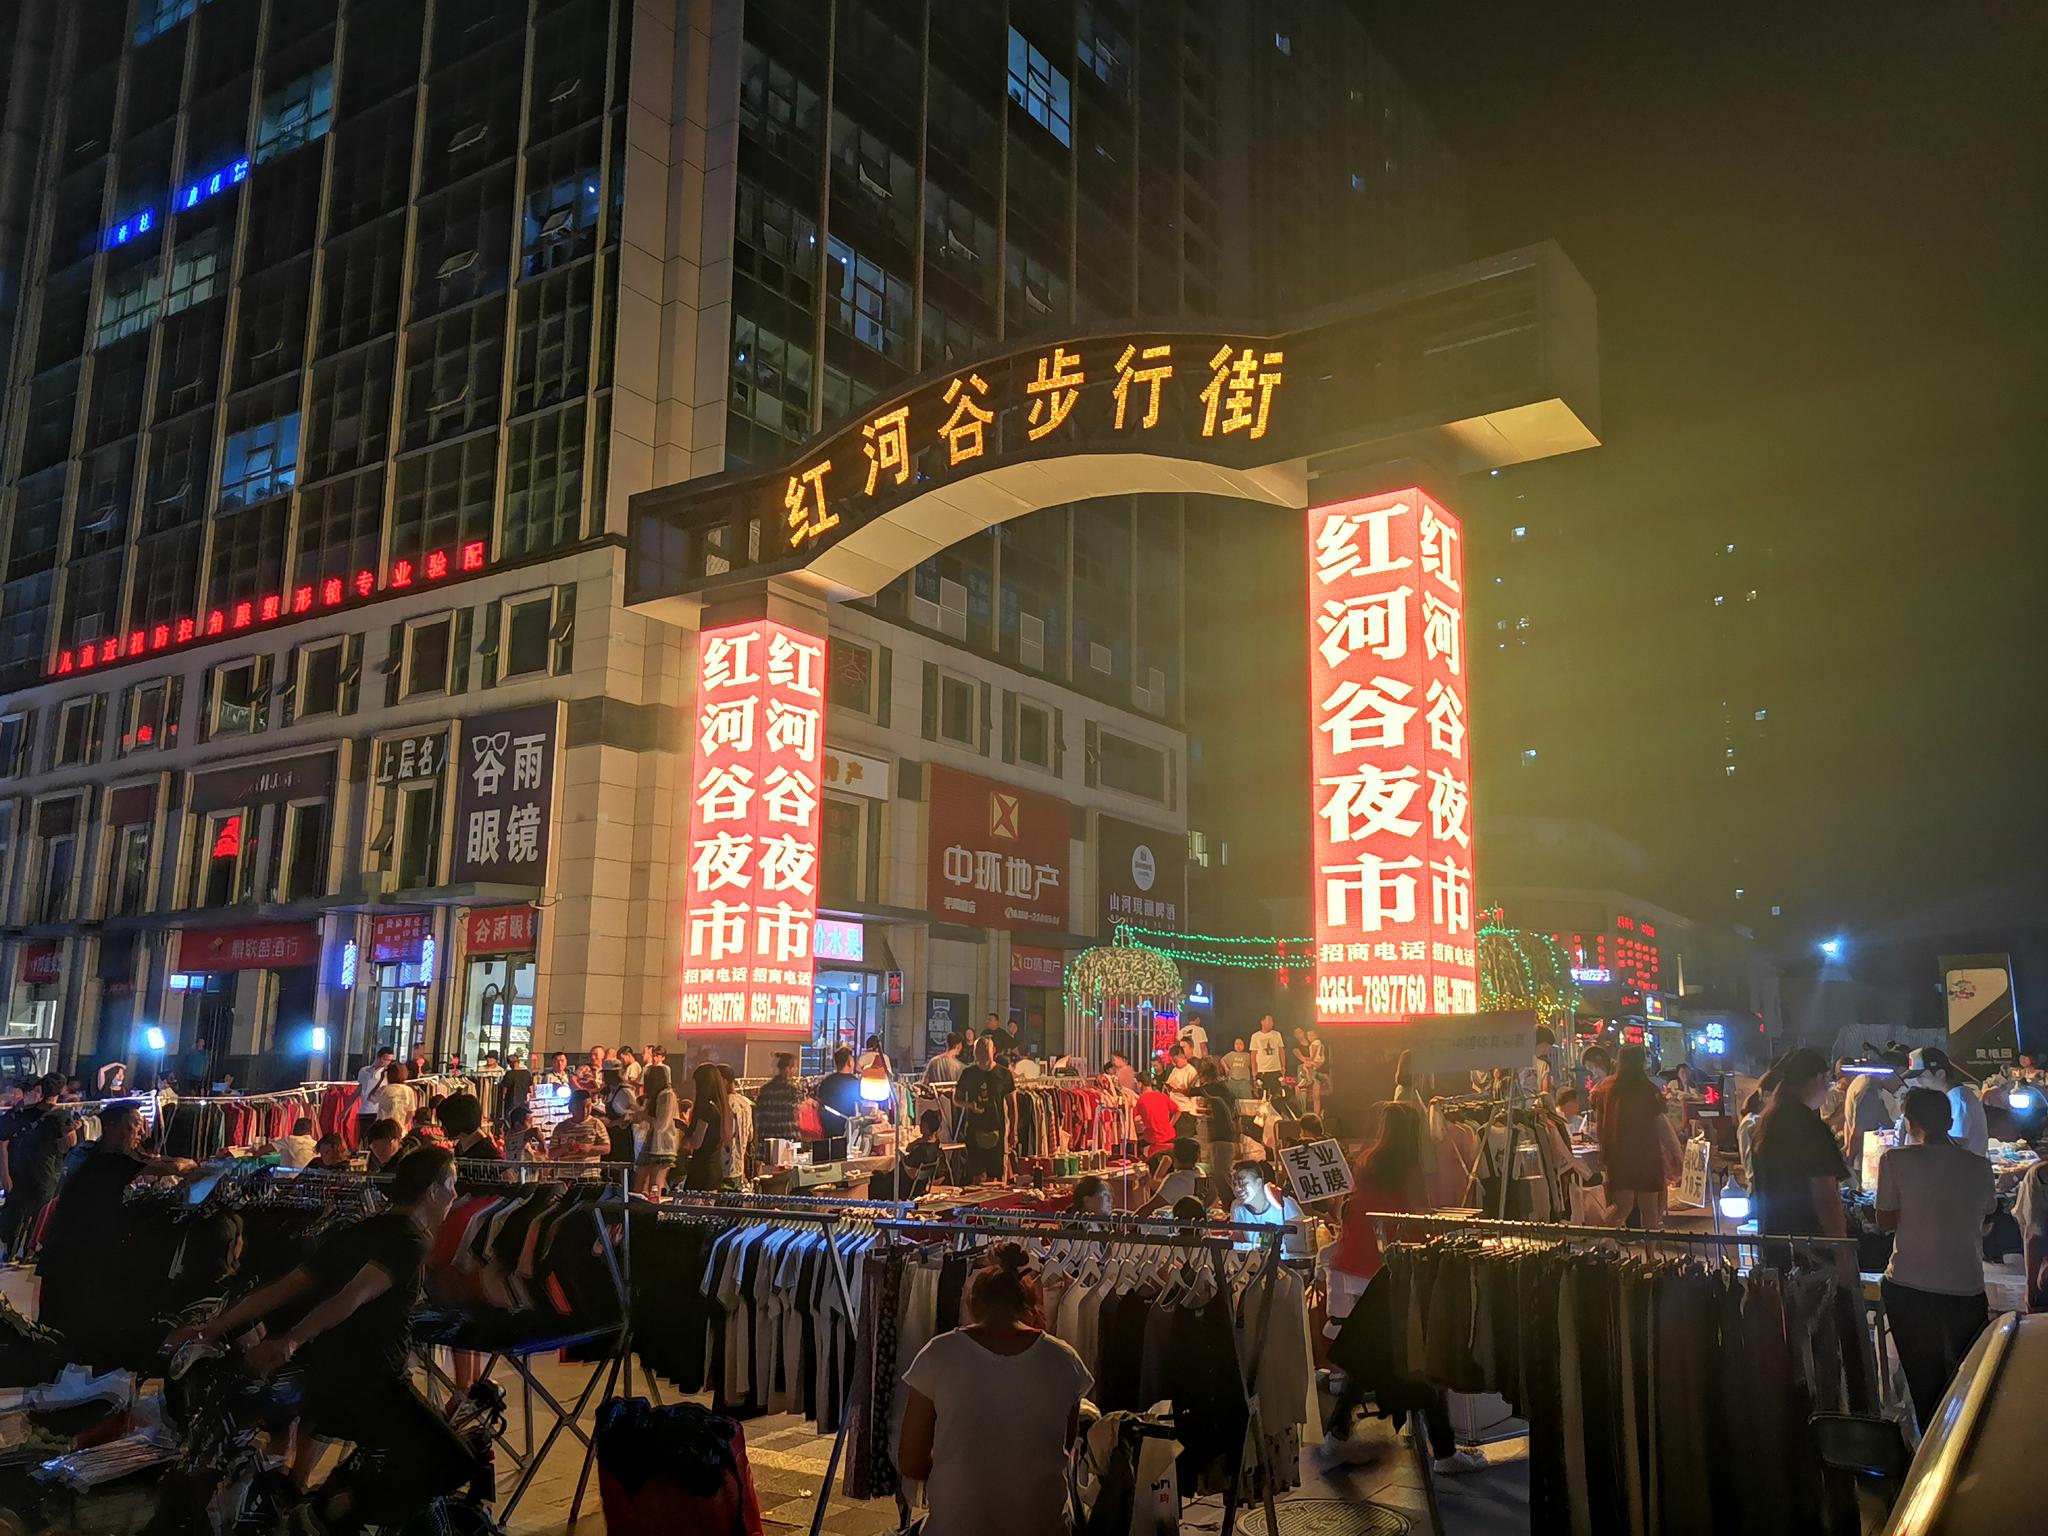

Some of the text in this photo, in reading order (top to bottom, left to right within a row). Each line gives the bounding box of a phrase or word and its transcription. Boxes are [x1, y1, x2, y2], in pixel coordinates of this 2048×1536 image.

[784, 344, 1283, 548] 红河谷步行街
[1316, 503, 1423, 933] 红河谷夜市
[1420, 505, 1472, 935] 红河谷夜市
[471, 731, 546, 797] 谷雨
[689, 631, 761, 961] 红河谷夜市
[755, 632, 822, 963] 红河谷夜市
[466, 802, 542, 866] 眼镜
[943, 844, 1060, 901] 中环地产
[684, 967, 748, 984] 招商电话
[752, 967, 813, 987] 招商电话
[1319, 941, 1426, 963] 招商电话
[1432, 941, 1475, 968] 招商电话
[1316, 974, 1427, 1014] 0351-7897760
[1289, 1145, 1338, 1170] 专业
[1298, 1167, 1349, 1198] 贴膜
